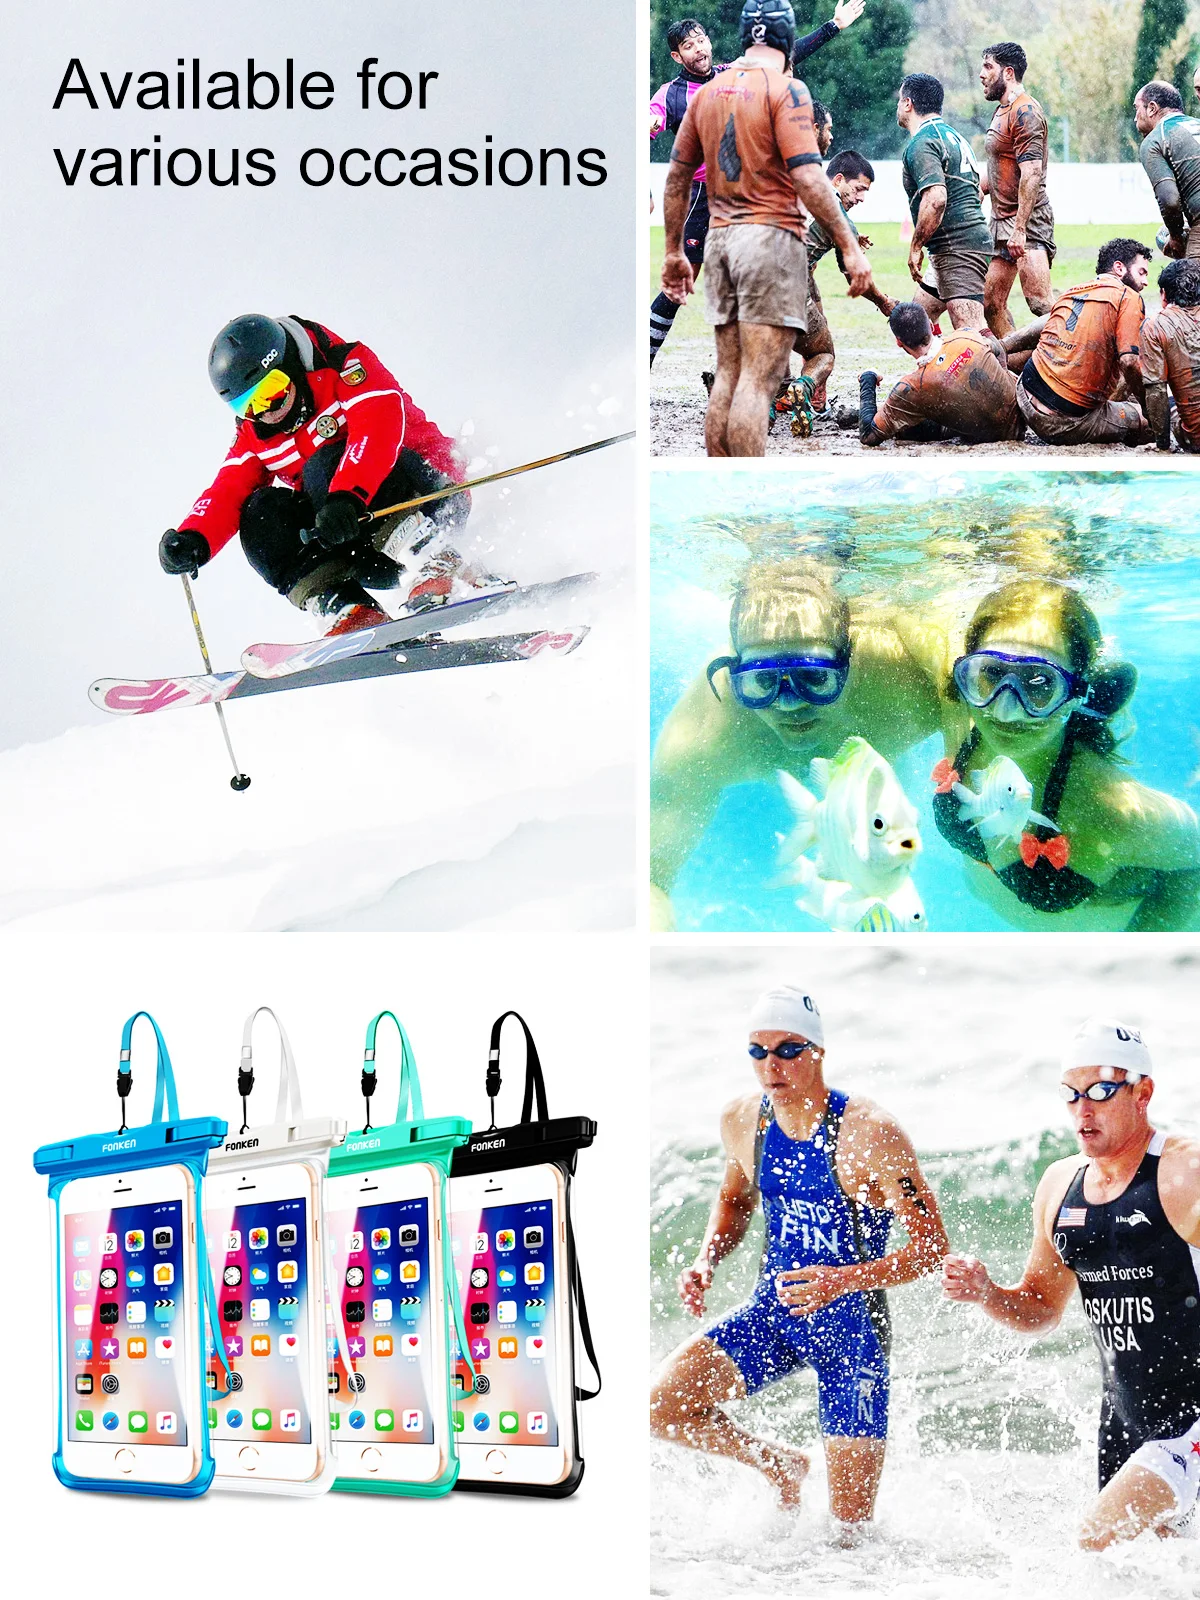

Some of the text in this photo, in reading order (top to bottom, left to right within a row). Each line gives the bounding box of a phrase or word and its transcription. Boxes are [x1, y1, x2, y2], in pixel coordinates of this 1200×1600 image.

[102, 1138, 137, 1153] FONKEN
[225, 1138, 259, 1152] FONKEN
[346, 1138, 381, 1153] FONKEN
[471, 1138, 506, 1153] FONKEN
[780, 1214, 840, 1254] FIN
[1110, 1264, 1154, 1281] Forces
[1100, 1325, 1142, 1351] USA
